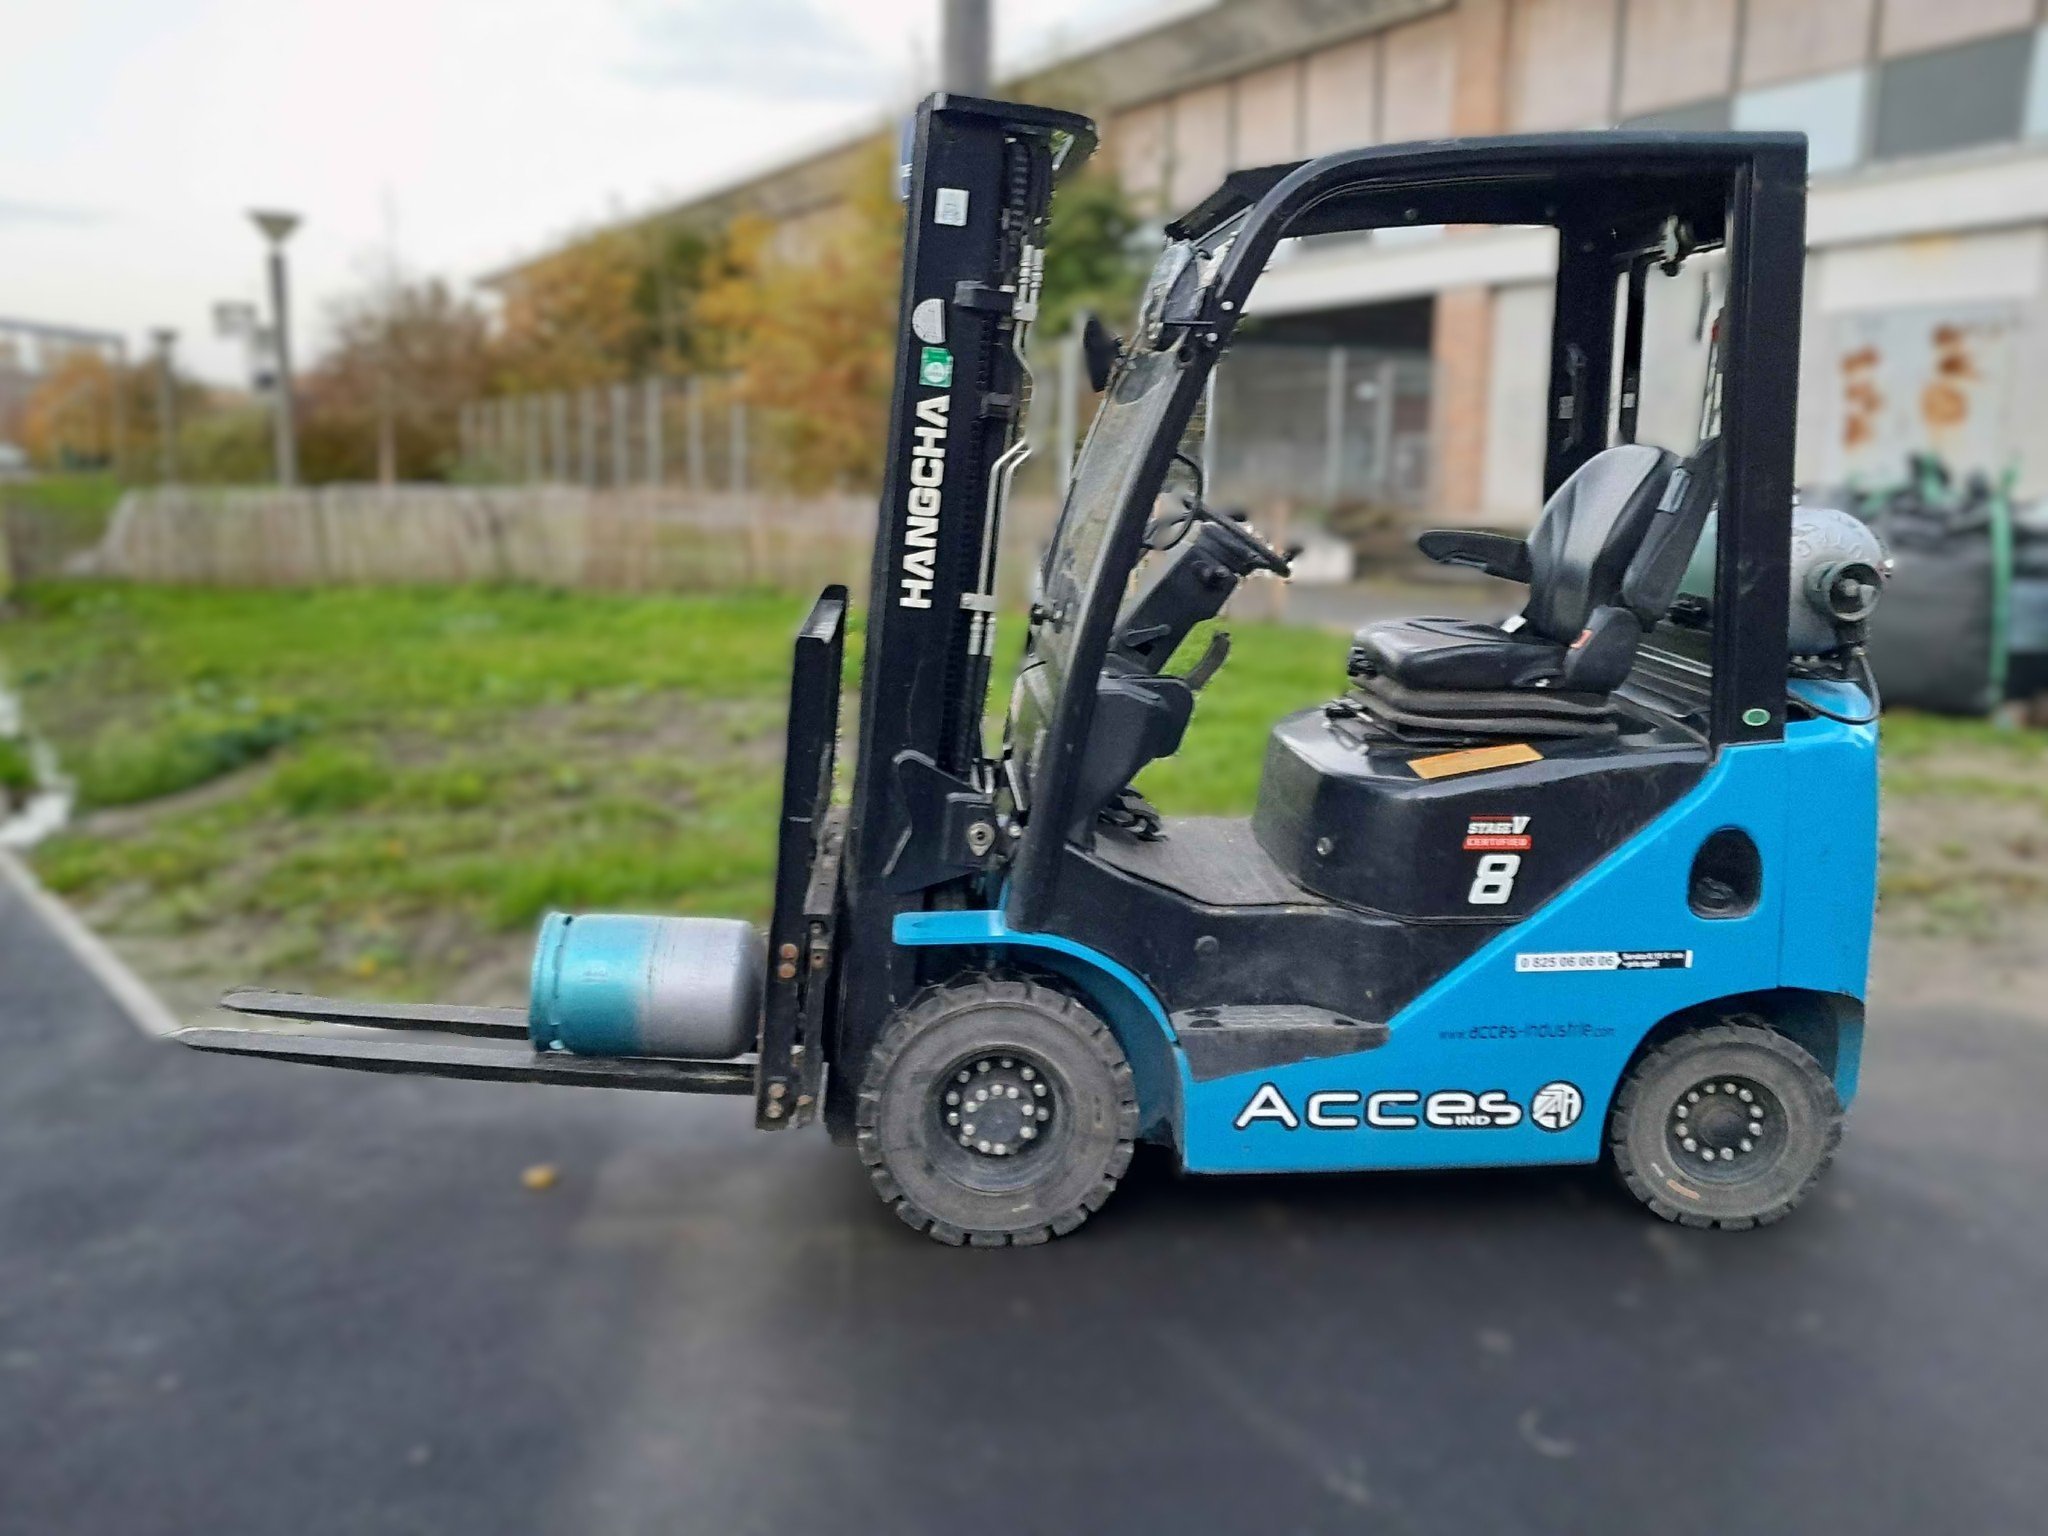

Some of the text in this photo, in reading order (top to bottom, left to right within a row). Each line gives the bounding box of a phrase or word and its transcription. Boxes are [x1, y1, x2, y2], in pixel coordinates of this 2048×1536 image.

[899, 394, 950, 609] HANGCHA
[1467, 853, 1521, 904] 8
[1520, 957, 1530, 969] 0
[1559, 956, 1576, 968] 06
[1578, 956, 1595, 967] 06
[1598, 955, 1616, 967] 06
